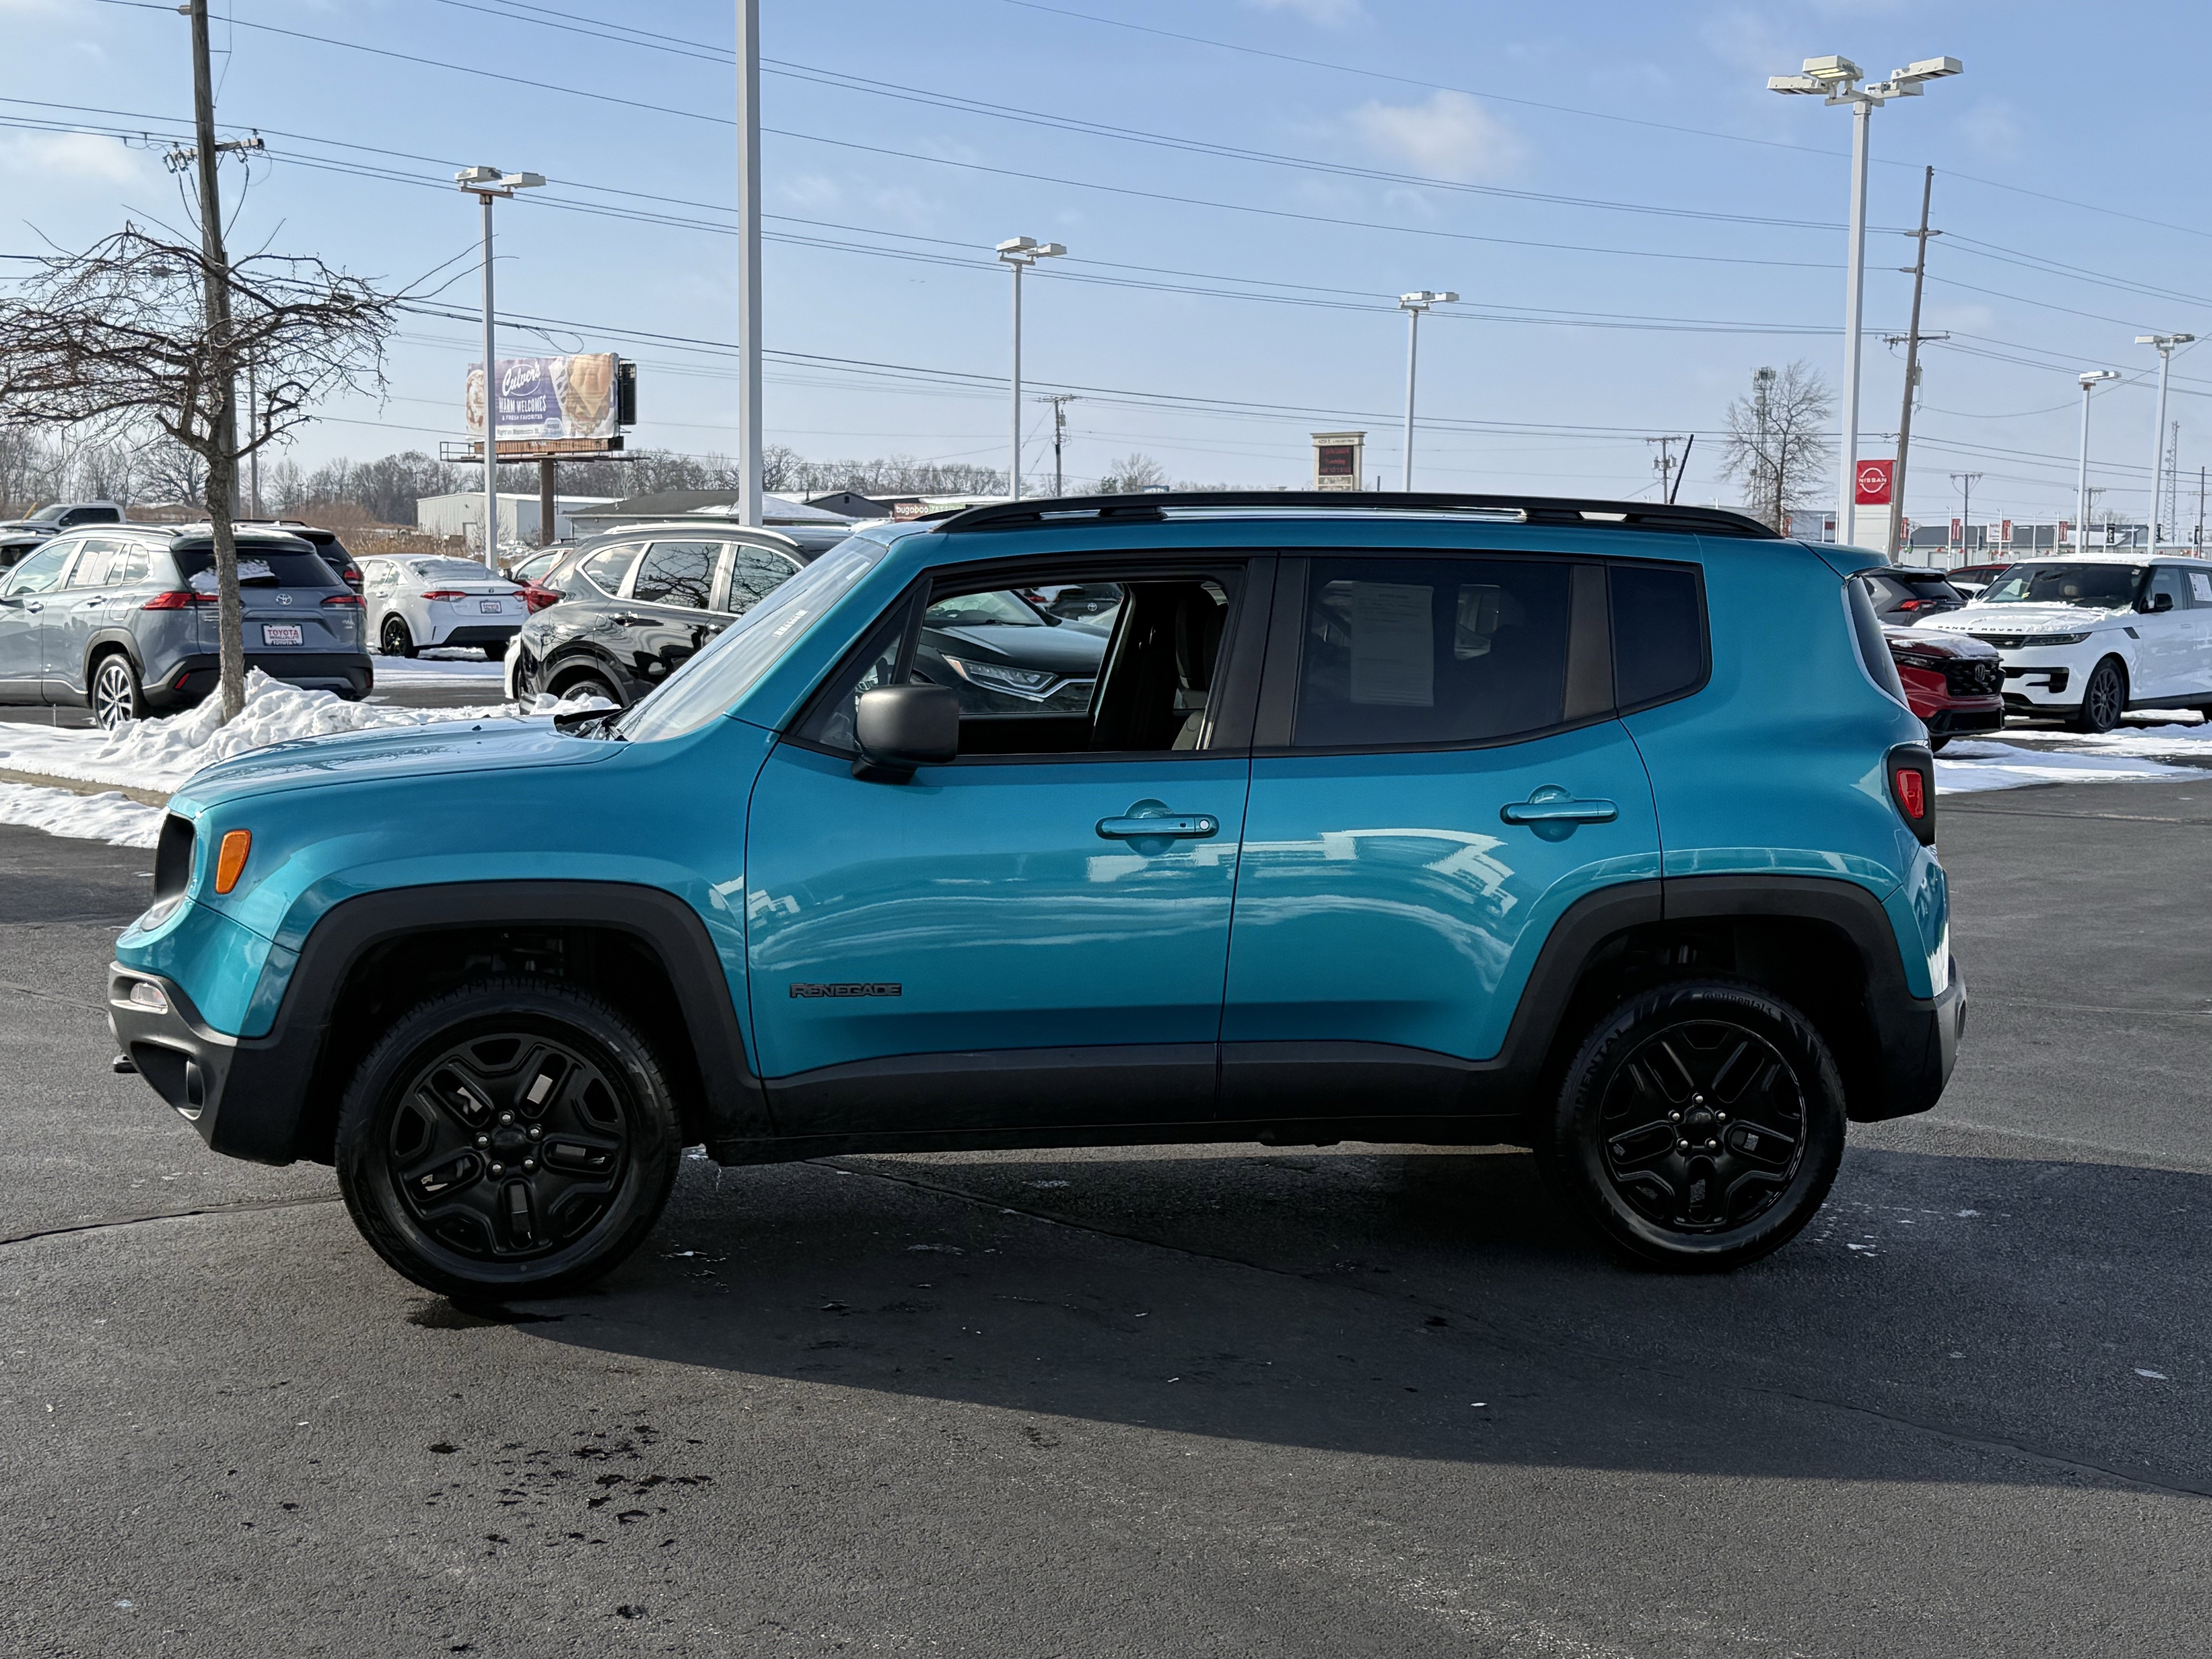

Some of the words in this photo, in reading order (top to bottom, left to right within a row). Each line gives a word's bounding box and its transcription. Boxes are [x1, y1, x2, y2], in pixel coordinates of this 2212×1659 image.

[502, 361, 541, 396] Culver's
[498, 397, 515, 413] WARM
[516, 395, 546, 412] WELCOMES
[896, 505, 929, 515] bugaboo
[790, 983, 902, 998] RENEGADE
